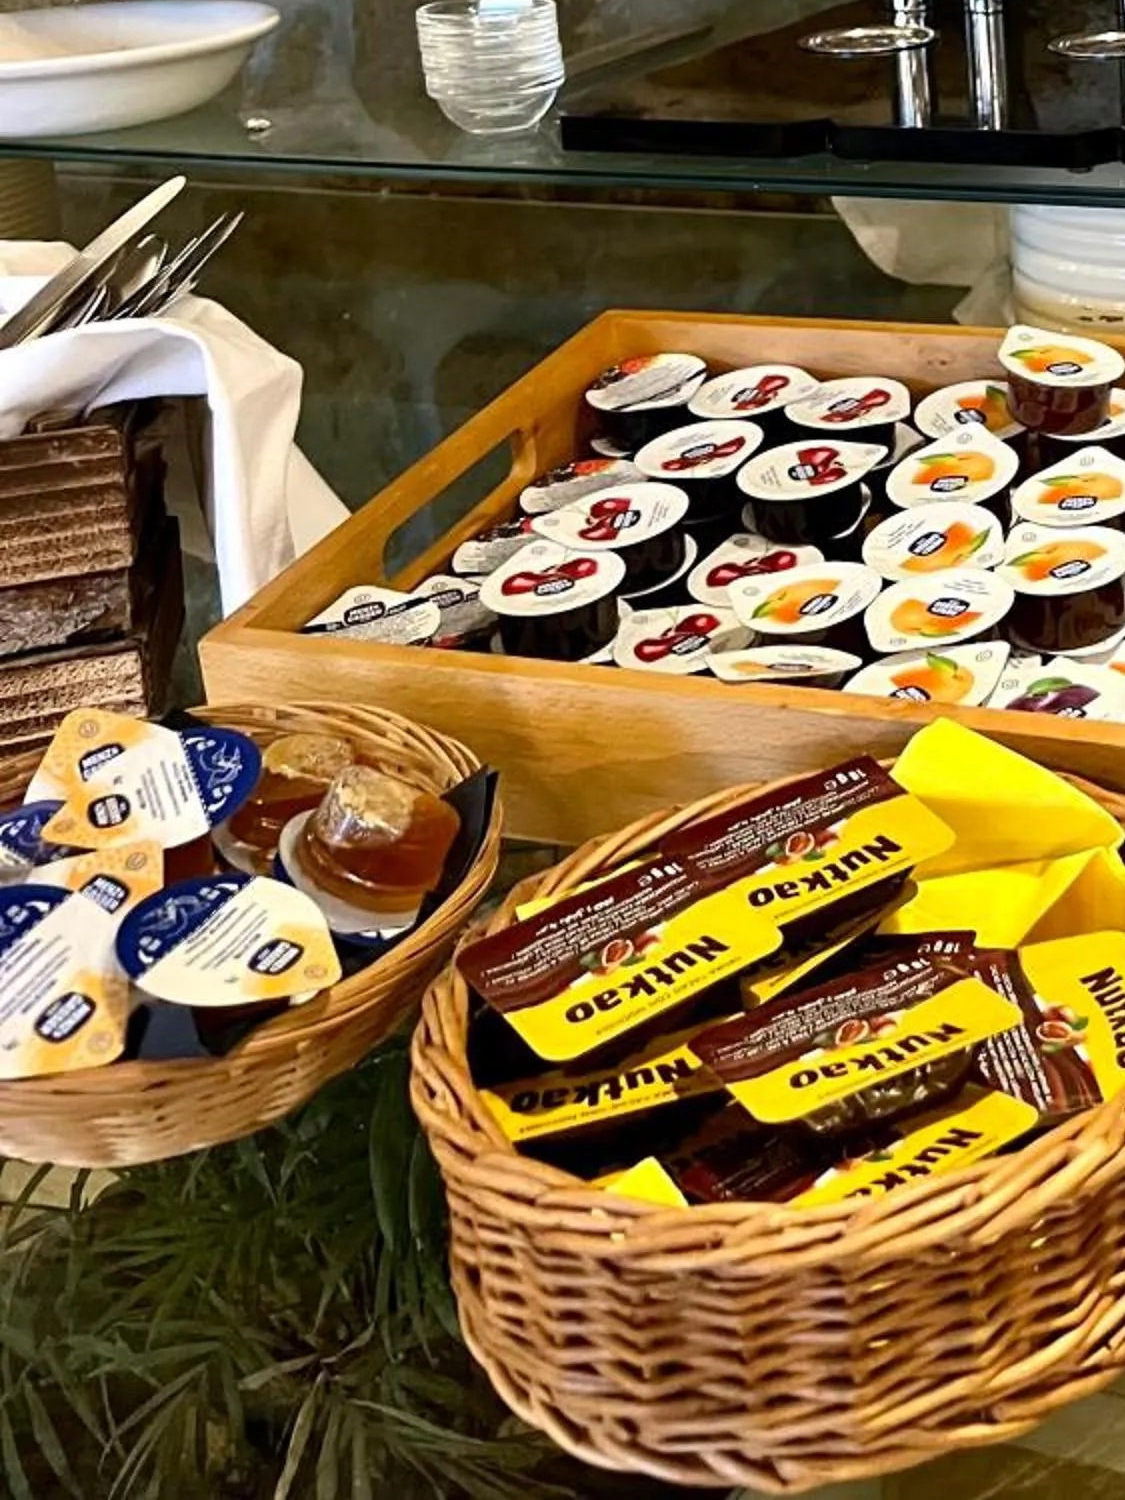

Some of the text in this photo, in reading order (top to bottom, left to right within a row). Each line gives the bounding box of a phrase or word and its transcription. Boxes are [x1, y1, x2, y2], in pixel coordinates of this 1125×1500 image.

[748, 834, 903, 907] Nutkao
[565, 935, 731, 1023] Nutkao
[509, 1057, 697, 1113] Nutkao
[789, 1022, 967, 1089] Nutkao
[842, 1127, 984, 1199] Nutk
